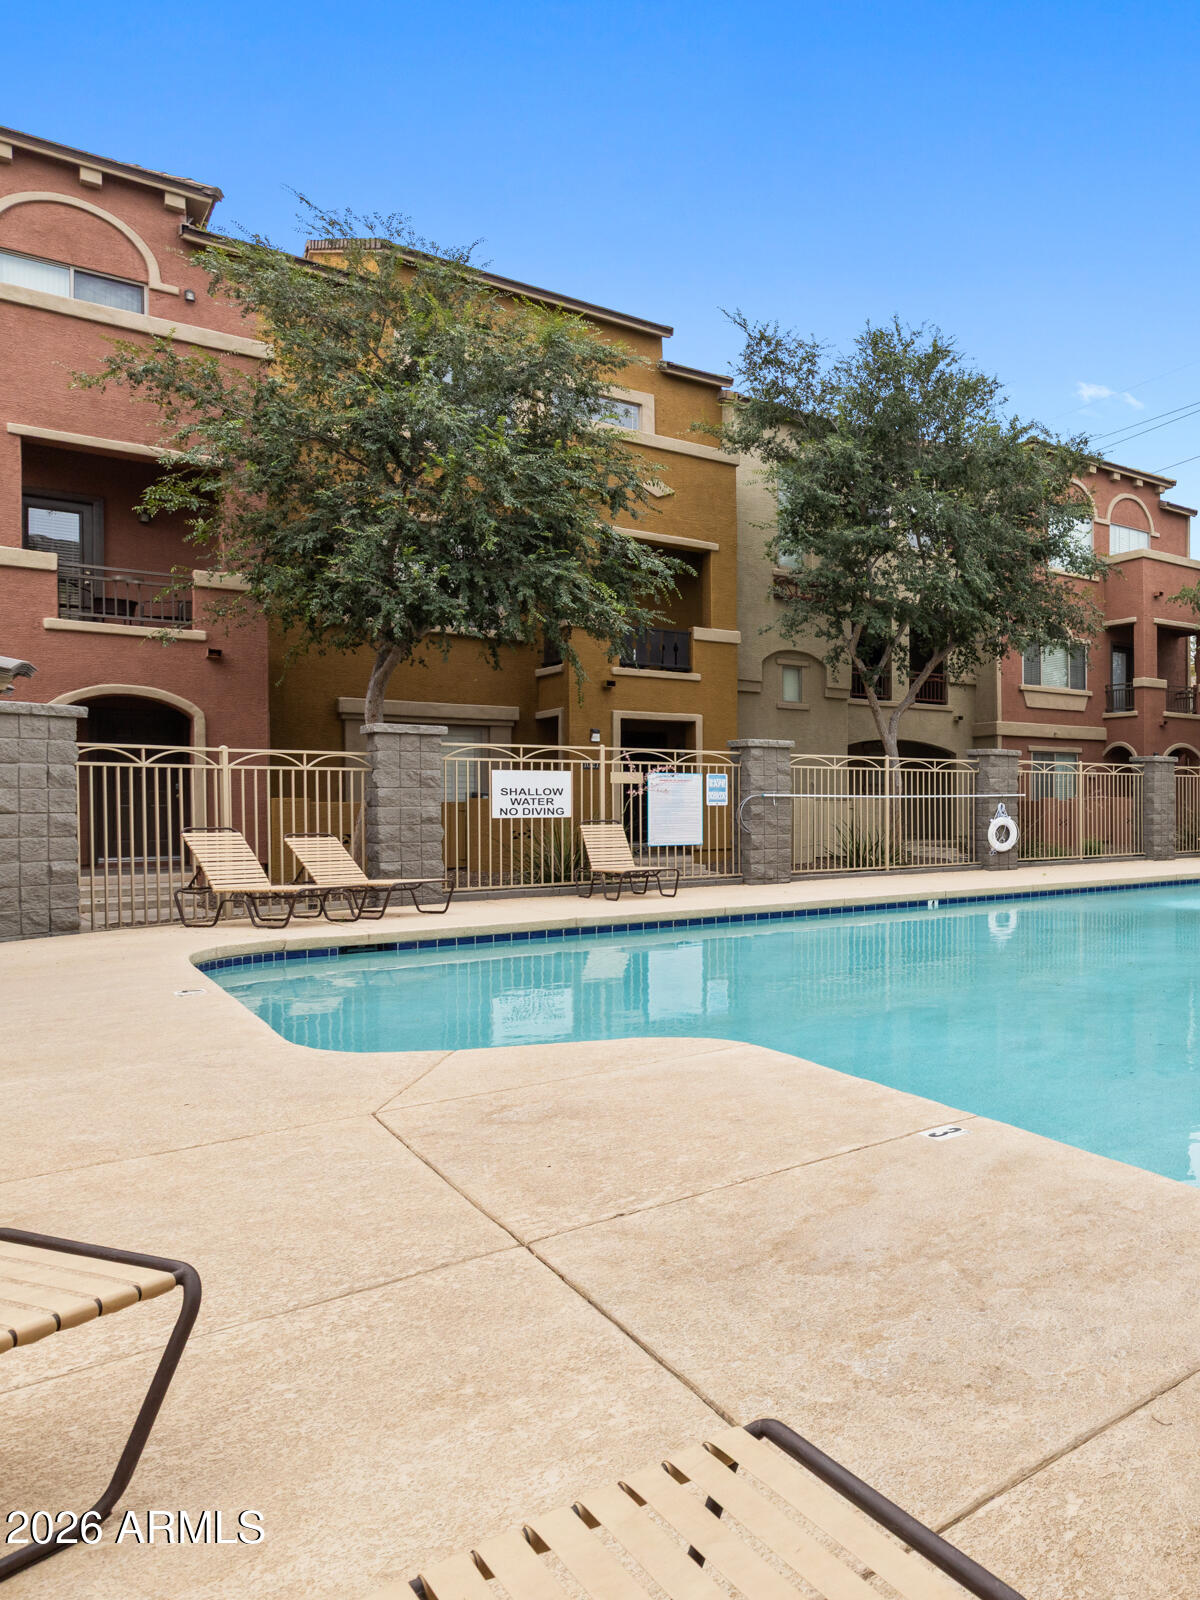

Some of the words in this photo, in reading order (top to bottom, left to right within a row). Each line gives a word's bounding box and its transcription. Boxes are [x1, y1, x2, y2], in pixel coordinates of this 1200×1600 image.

[500, 787, 564, 796] SHALLOW
[510, 797, 554, 806] WATER
[499, 807, 519, 816] NO
[522, 807, 565, 816] DIVING
